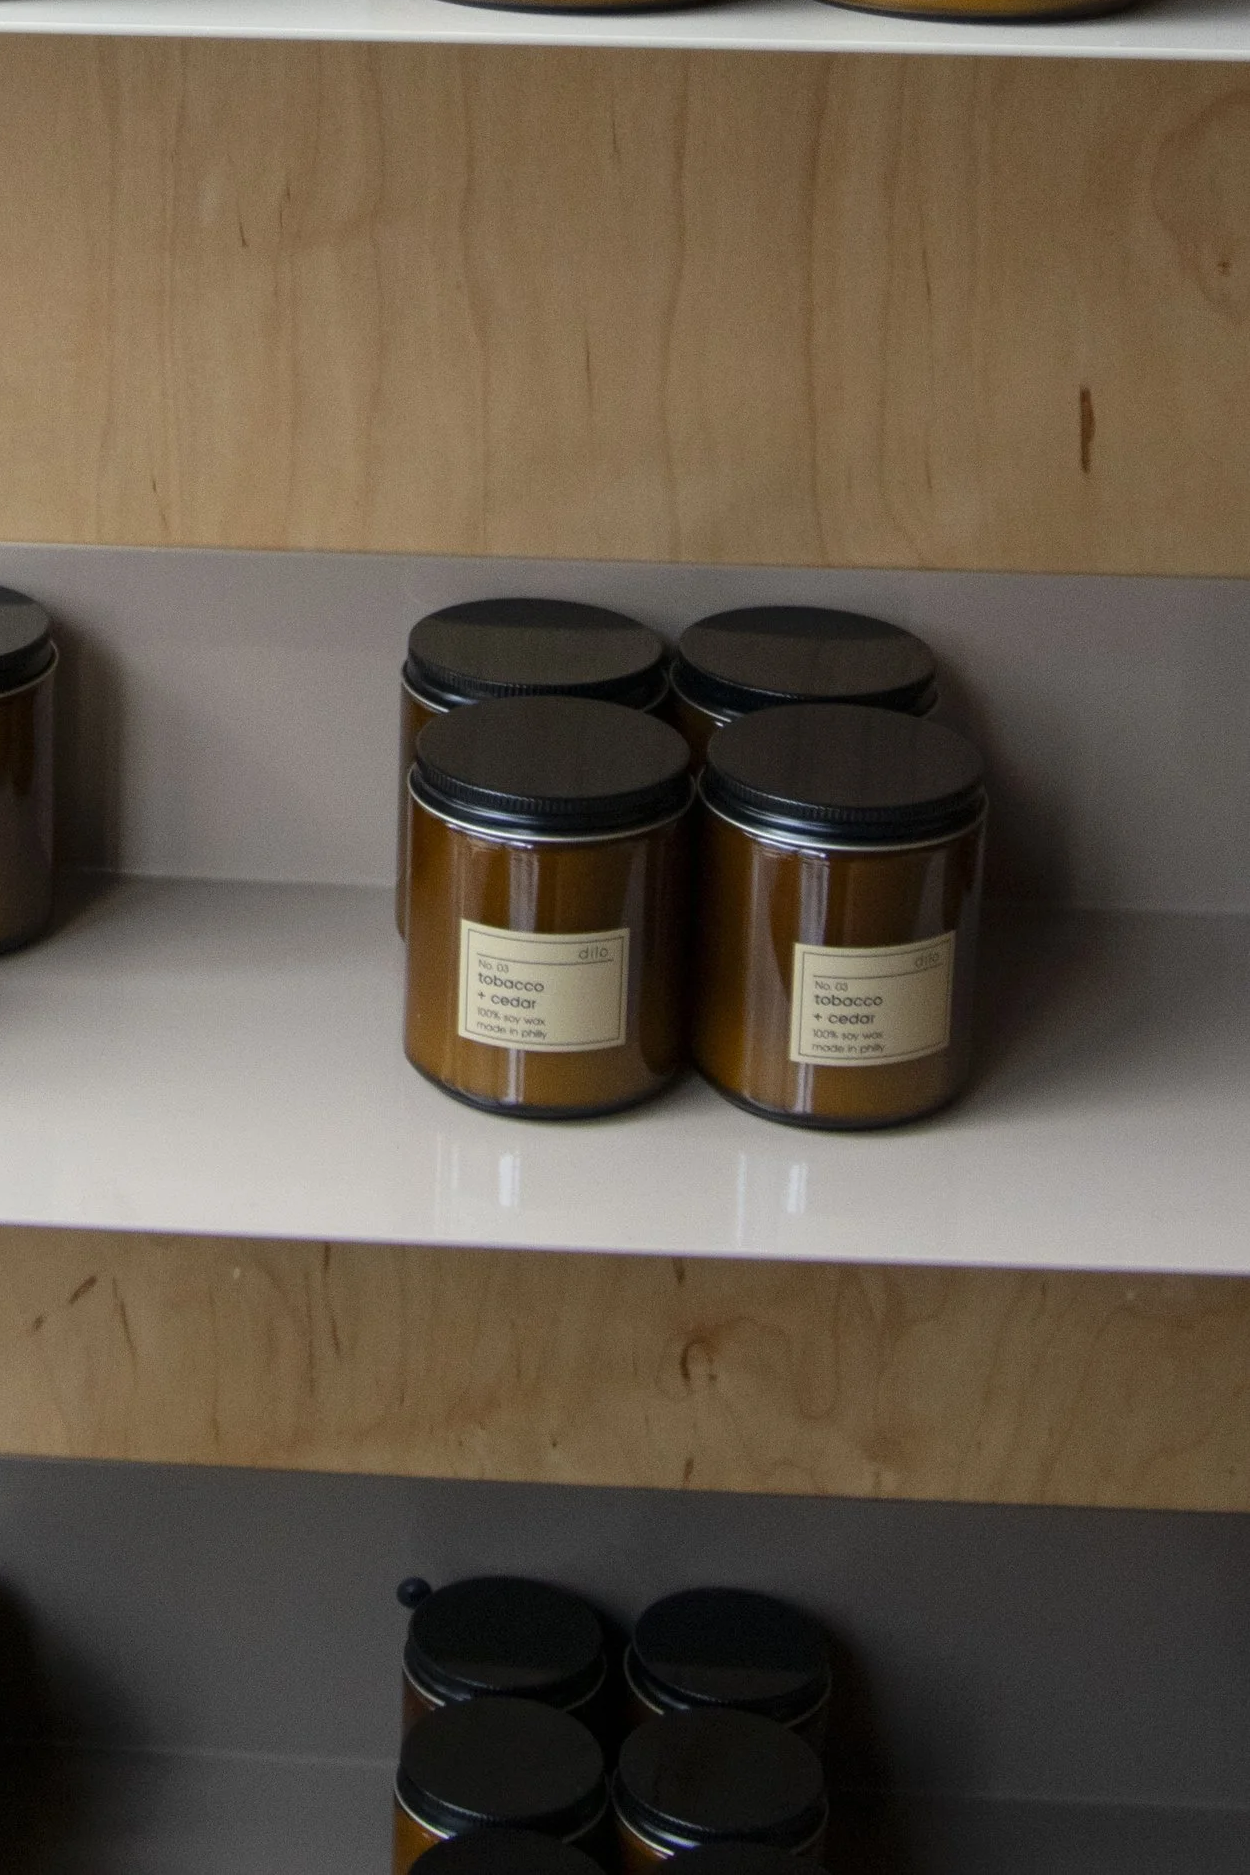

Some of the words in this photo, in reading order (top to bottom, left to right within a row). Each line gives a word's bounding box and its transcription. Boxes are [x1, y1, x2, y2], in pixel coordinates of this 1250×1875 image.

[578, 946, 609, 960] dilo
[496, 963, 509, 974] 03
[478, 972, 545, 993] tobacco
[477, 991, 486, 1000] +
[490, 993, 537, 1010] cedar
[814, 994, 883, 1007] tobacco
[523, 1016, 546, 1026] wax
[813, 1012, 822, 1021] +
[828, 1013, 876, 1025] cedar
[477, 1021, 507, 1034] made
[509, 1025, 519, 1036] in
[521, 1028, 548, 1040] philly
